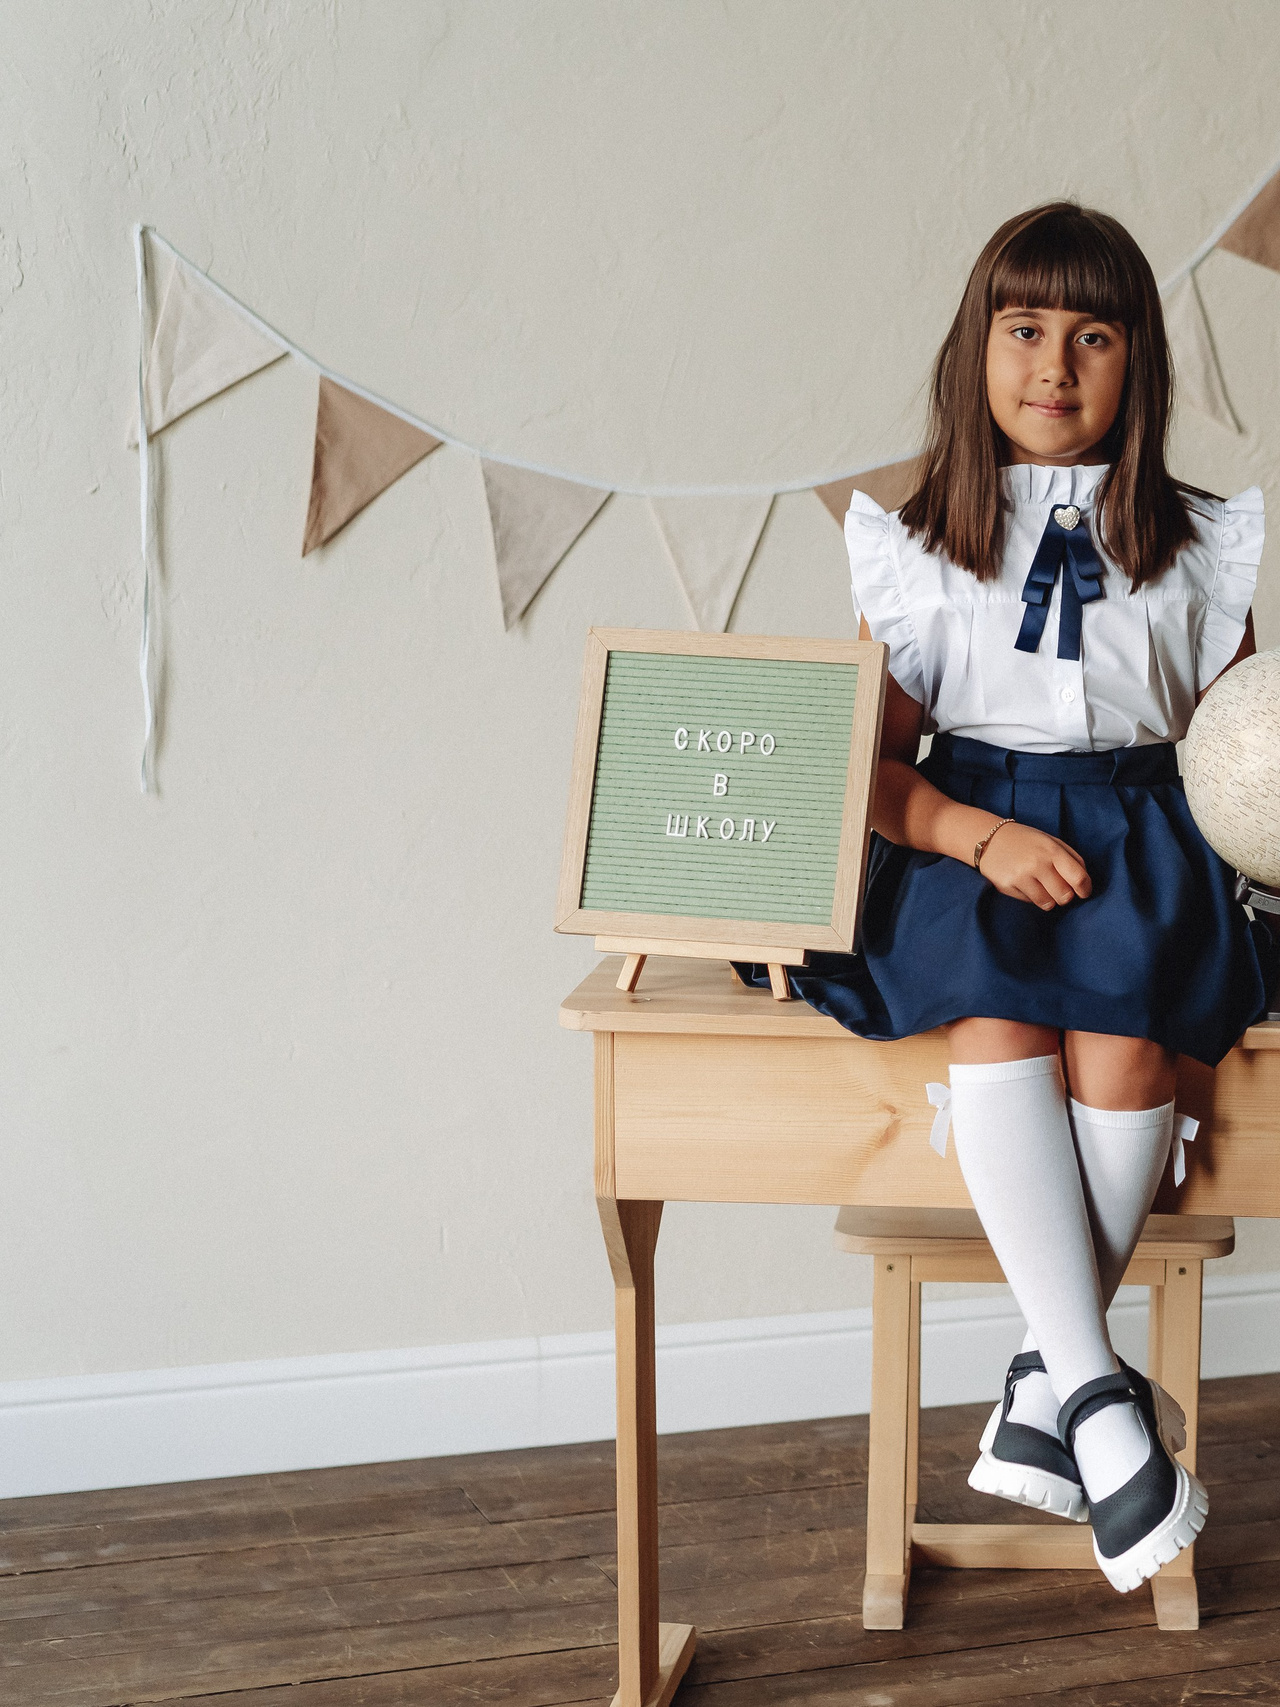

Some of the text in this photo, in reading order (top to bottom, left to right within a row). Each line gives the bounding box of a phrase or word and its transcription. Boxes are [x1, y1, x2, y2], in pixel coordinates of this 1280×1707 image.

[674, 727, 776, 756] СКОРО
[713, 773, 729, 797] В
[665, 813, 777, 843] ШКОЛУ
